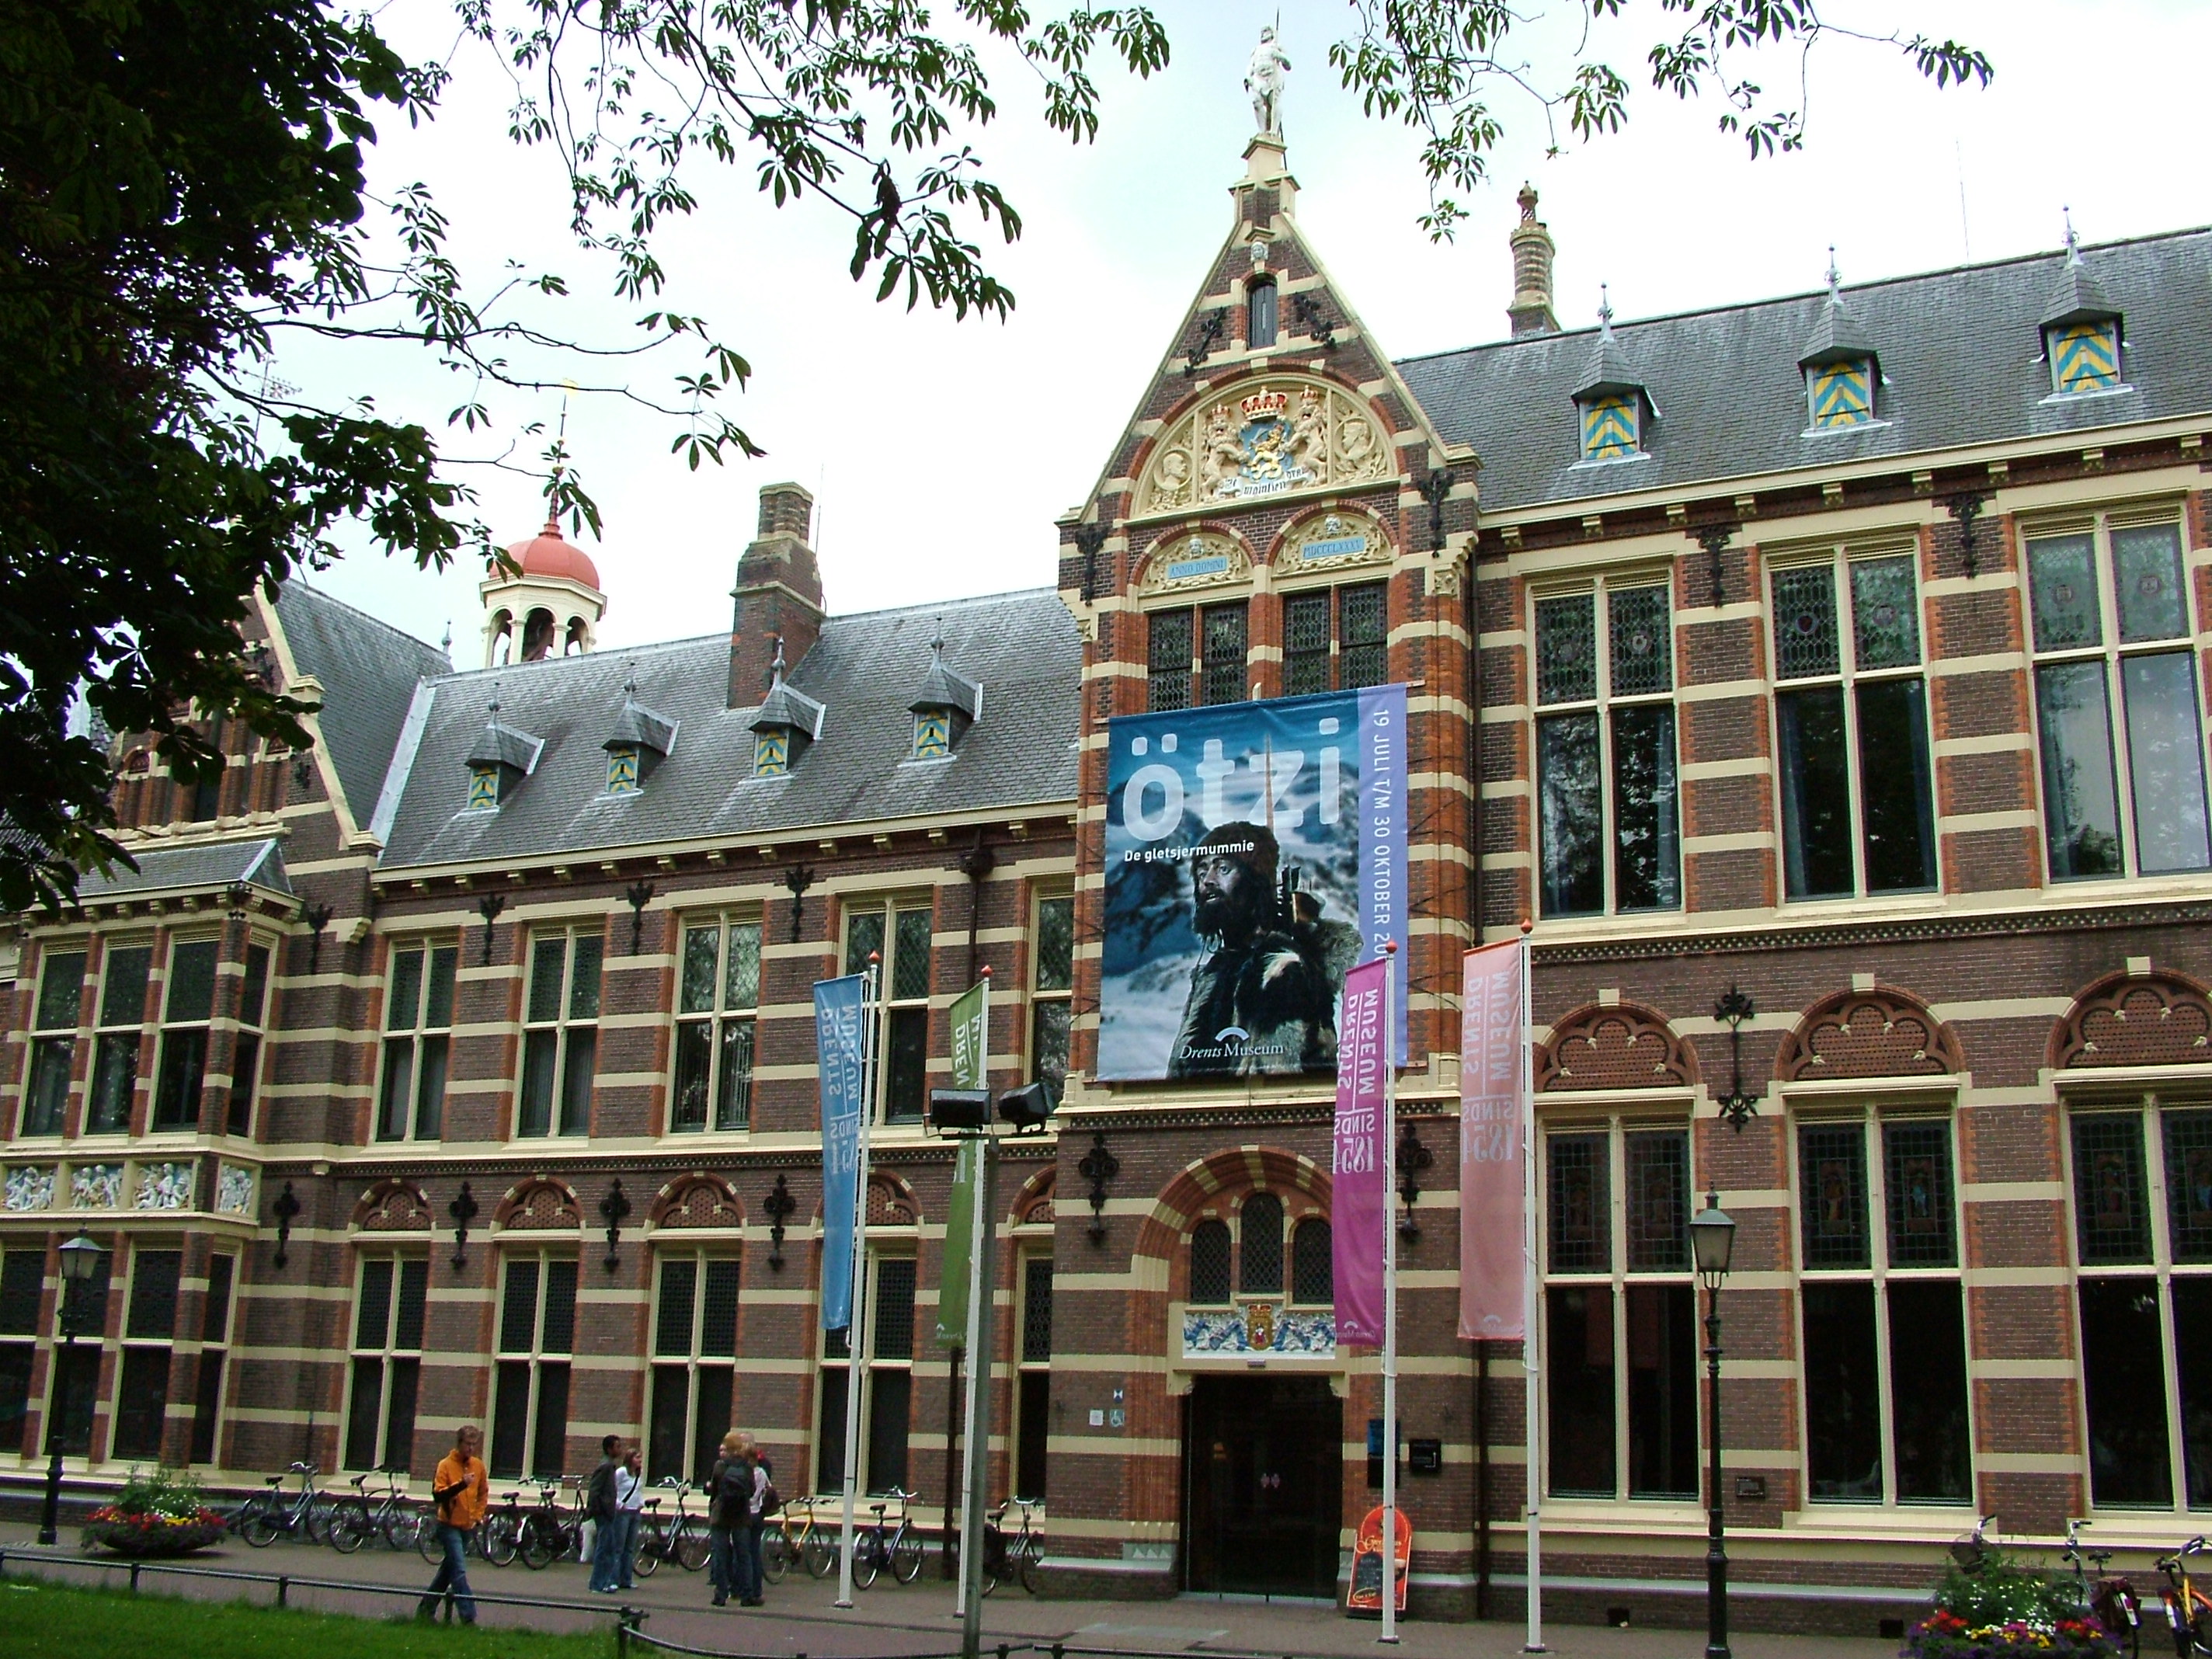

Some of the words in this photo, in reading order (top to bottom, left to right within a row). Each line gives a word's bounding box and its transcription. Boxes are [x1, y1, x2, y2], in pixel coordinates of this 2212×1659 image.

[1170, 564, 1193, 578] ANNO
[1195, 558, 1224, 572] DOMINI
[1373, 709, 1390, 726] 19
[1374, 734, 1390, 772] JULI
[1122, 718, 1340, 841] ötzi
[1372, 778, 1392, 809] T/M
[1374, 816, 1391, 838] 30
[1124, 849, 1141, 863] De
[1144, 840, 1255, 864] gletsjermummie
[1374, 845, 1391, 924] OKTOBER
[1373, 933, 1391, 961] 20
[1178, 1045, 1223, 1059] Drents
[1224, 1042, 1285, 1057] Museum
